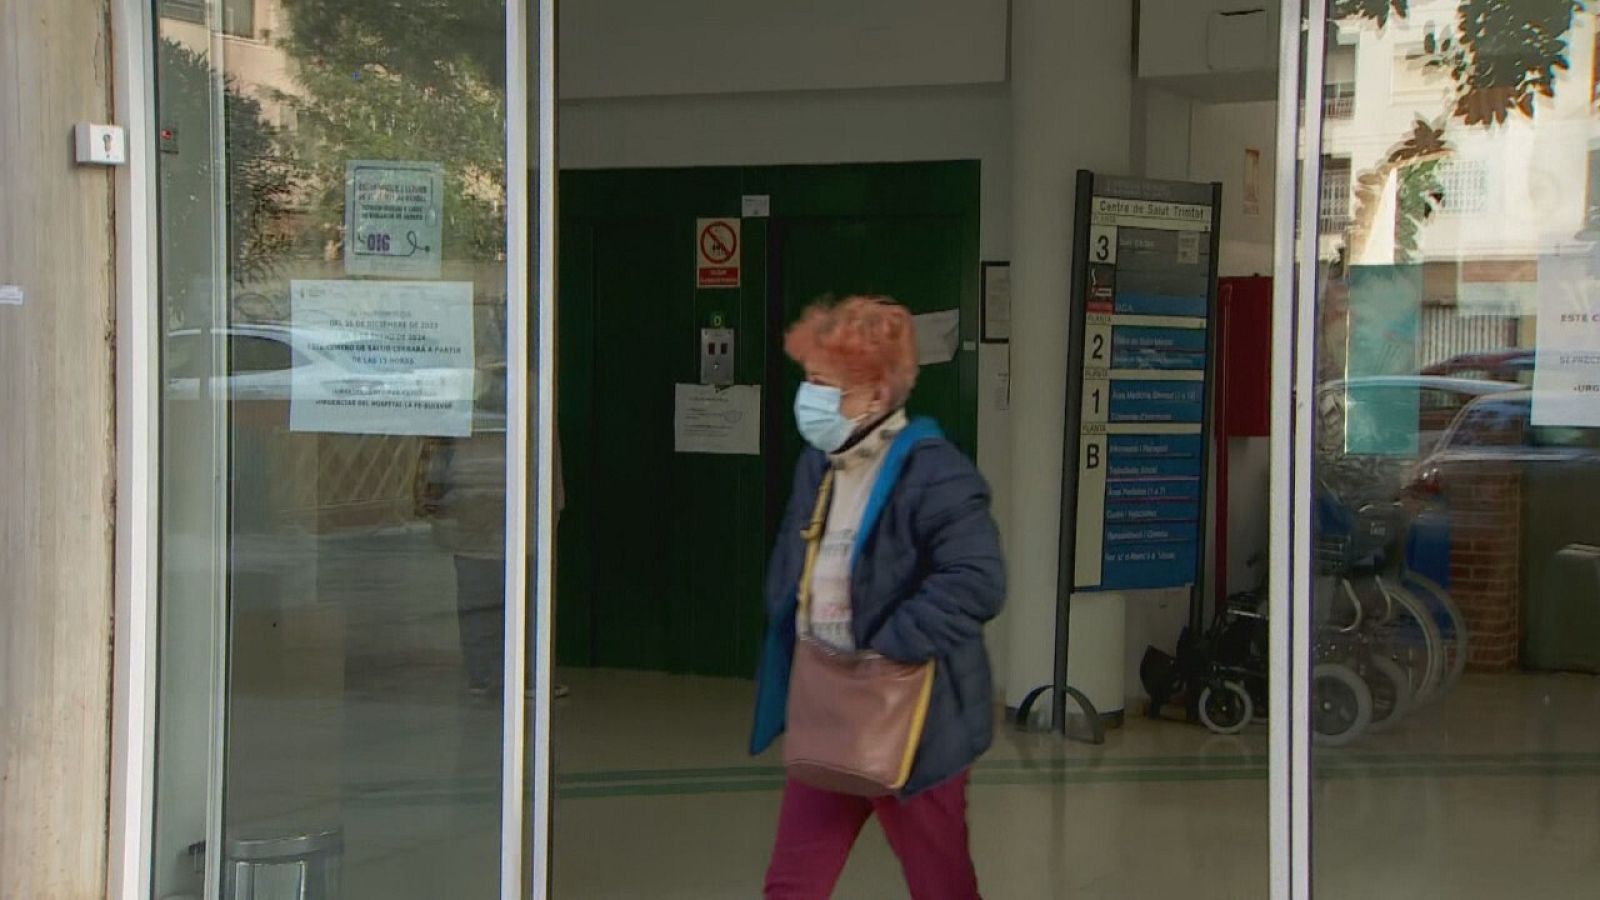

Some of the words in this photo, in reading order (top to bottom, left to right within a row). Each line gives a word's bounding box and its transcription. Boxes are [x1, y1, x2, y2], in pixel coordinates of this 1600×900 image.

[1100, 201, 1130, 212] Centre
[1148, 204, 1170, 215] Salut
[1096, 235, 1109, 260] 3
[1560, 313, 1587, 322] ESTE
[368, 344, 391, 352] SALUD
[1092, 334, 1104, 360] 2
[1091, 388, 1100, 414] 1
[1086, 443, 1099, 469] B
